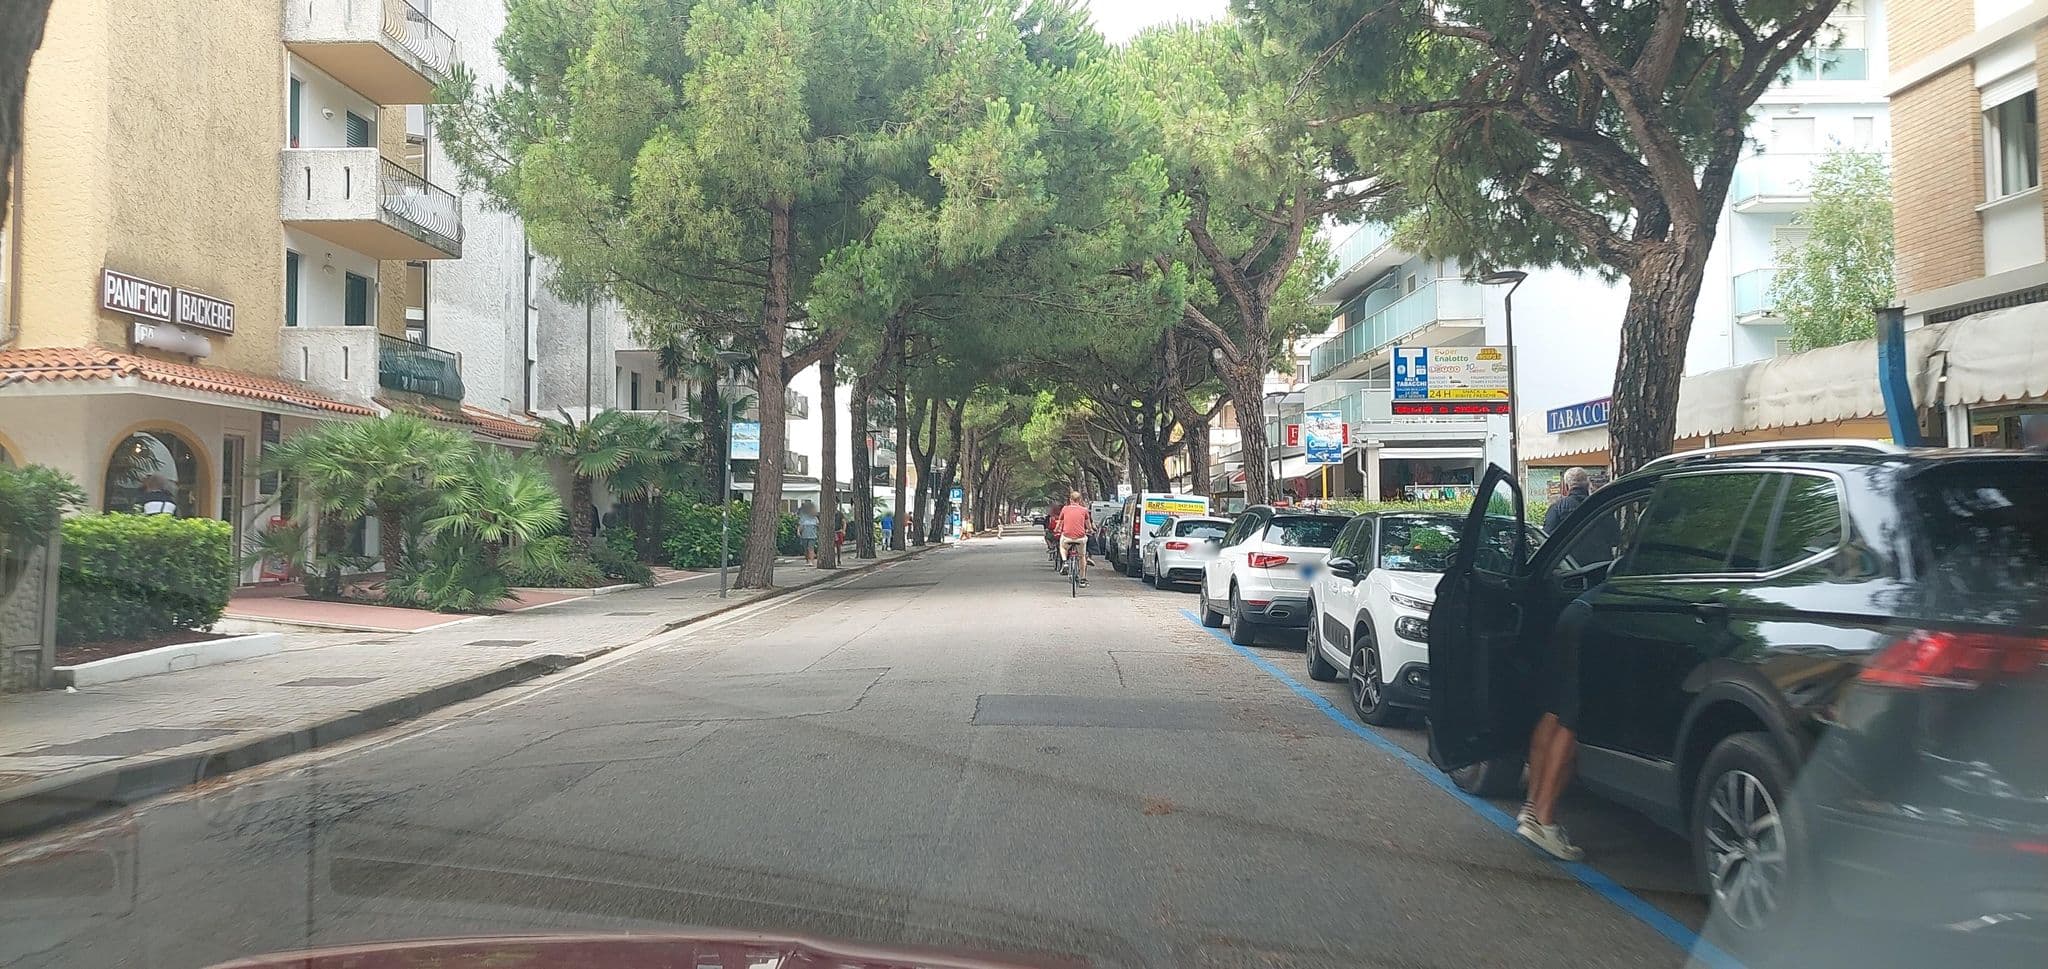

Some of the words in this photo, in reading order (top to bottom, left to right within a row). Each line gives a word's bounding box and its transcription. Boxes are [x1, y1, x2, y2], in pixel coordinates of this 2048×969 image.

[107, 275, 170, 317] PANIFICIO
[1429, 390, 1442, 398] 24
[1444, 390, 1451, 398] H
[1550, 400, 1611, 430] TABACCH
